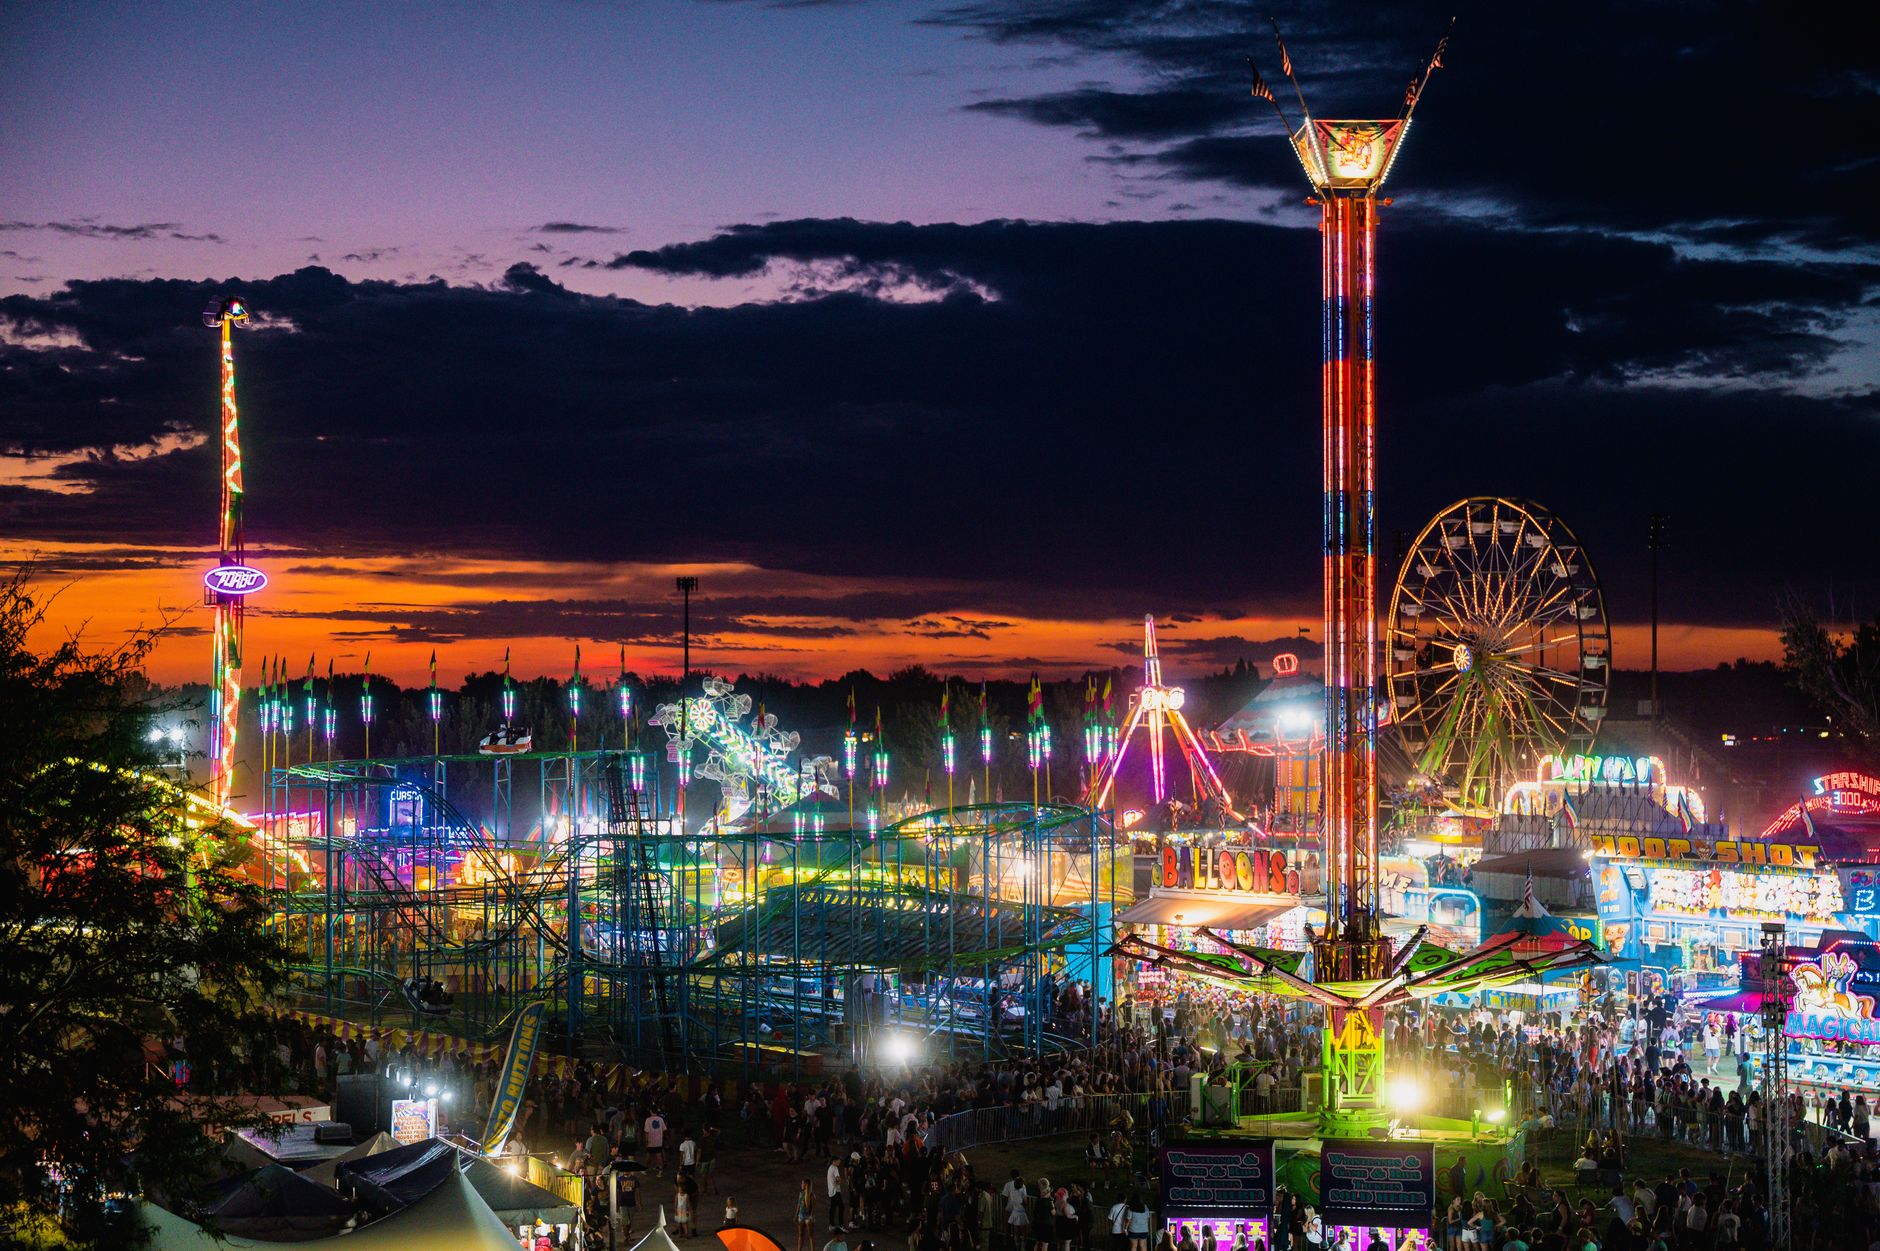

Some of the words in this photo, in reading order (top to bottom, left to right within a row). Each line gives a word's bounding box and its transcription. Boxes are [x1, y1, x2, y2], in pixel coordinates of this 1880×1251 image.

[214, 571, 262, 589] TURBO
[1813, 772, 1880, 796] STARSHIP
[1833, 791, 1861, 806] 3000
[1592, 835, 1691, 859] HOOP
[1715, 841, 1819, 869] SHOT
[1163, 846, 1287, 894] BALLOONS
[506, 1015, 537, 1098] BUTTONS
[1329, 1189, 1373, 1203] SOLD
